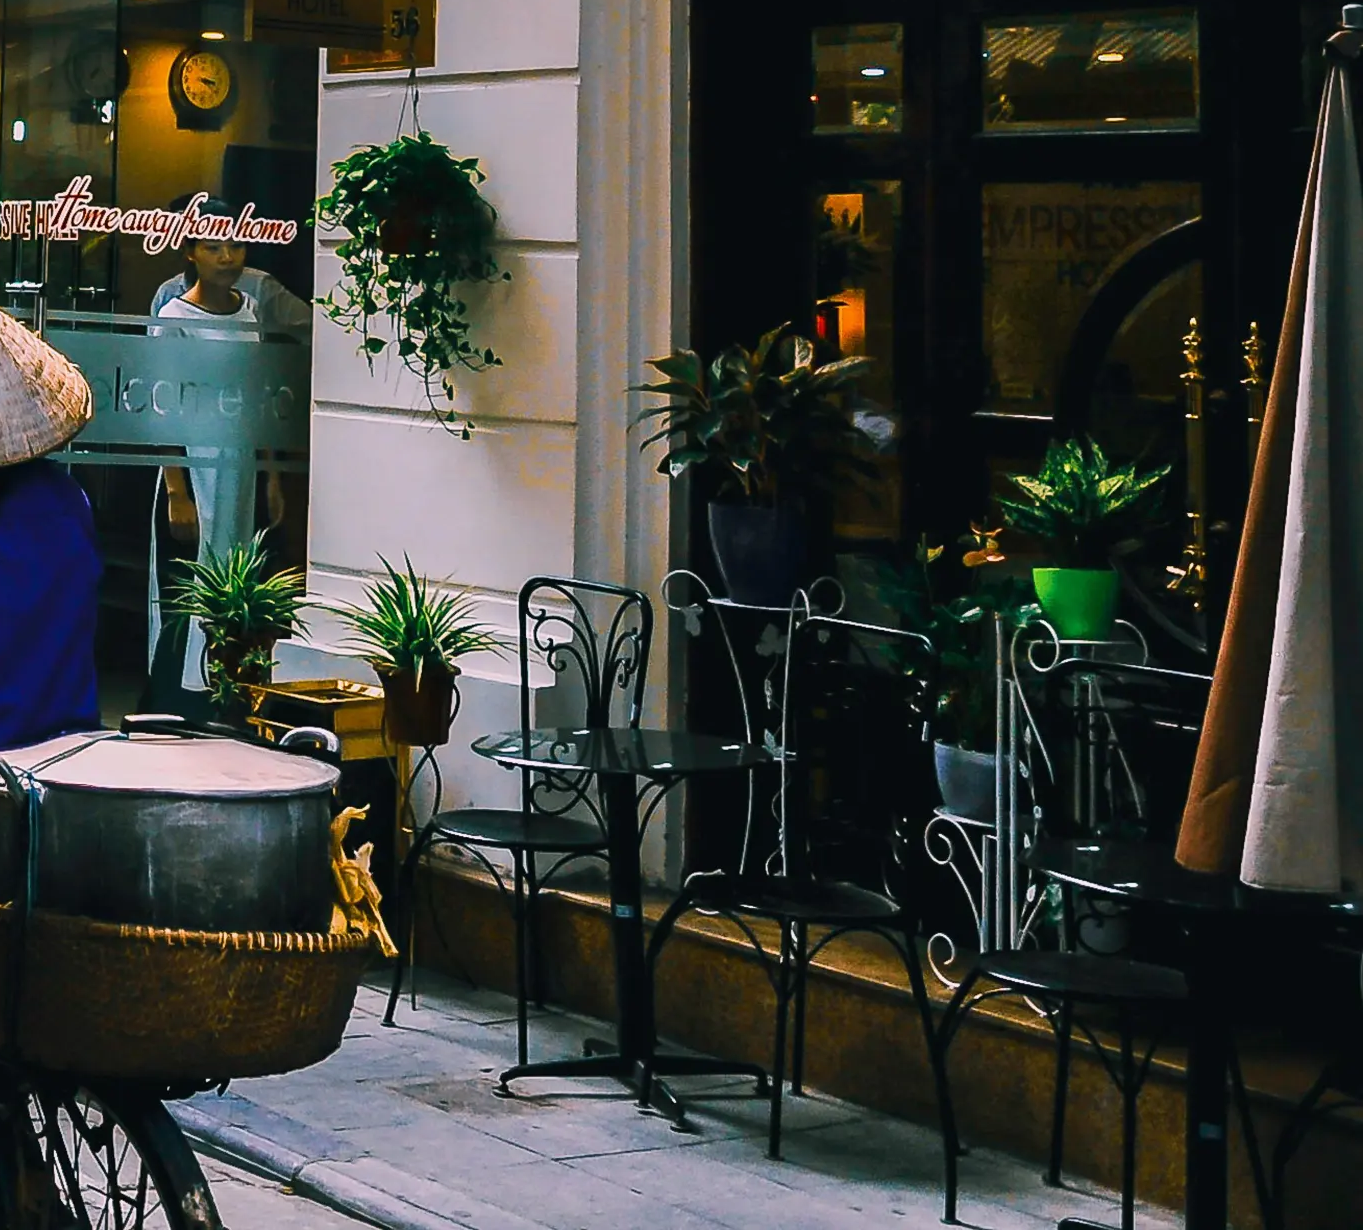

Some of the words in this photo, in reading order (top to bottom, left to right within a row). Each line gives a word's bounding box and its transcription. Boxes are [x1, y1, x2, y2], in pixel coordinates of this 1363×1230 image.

[52, 174, 119, 232] Home
[119, 208, 176, 255] away
[173, 192, 233, 250] from
[232, 201, 297, 245] home
